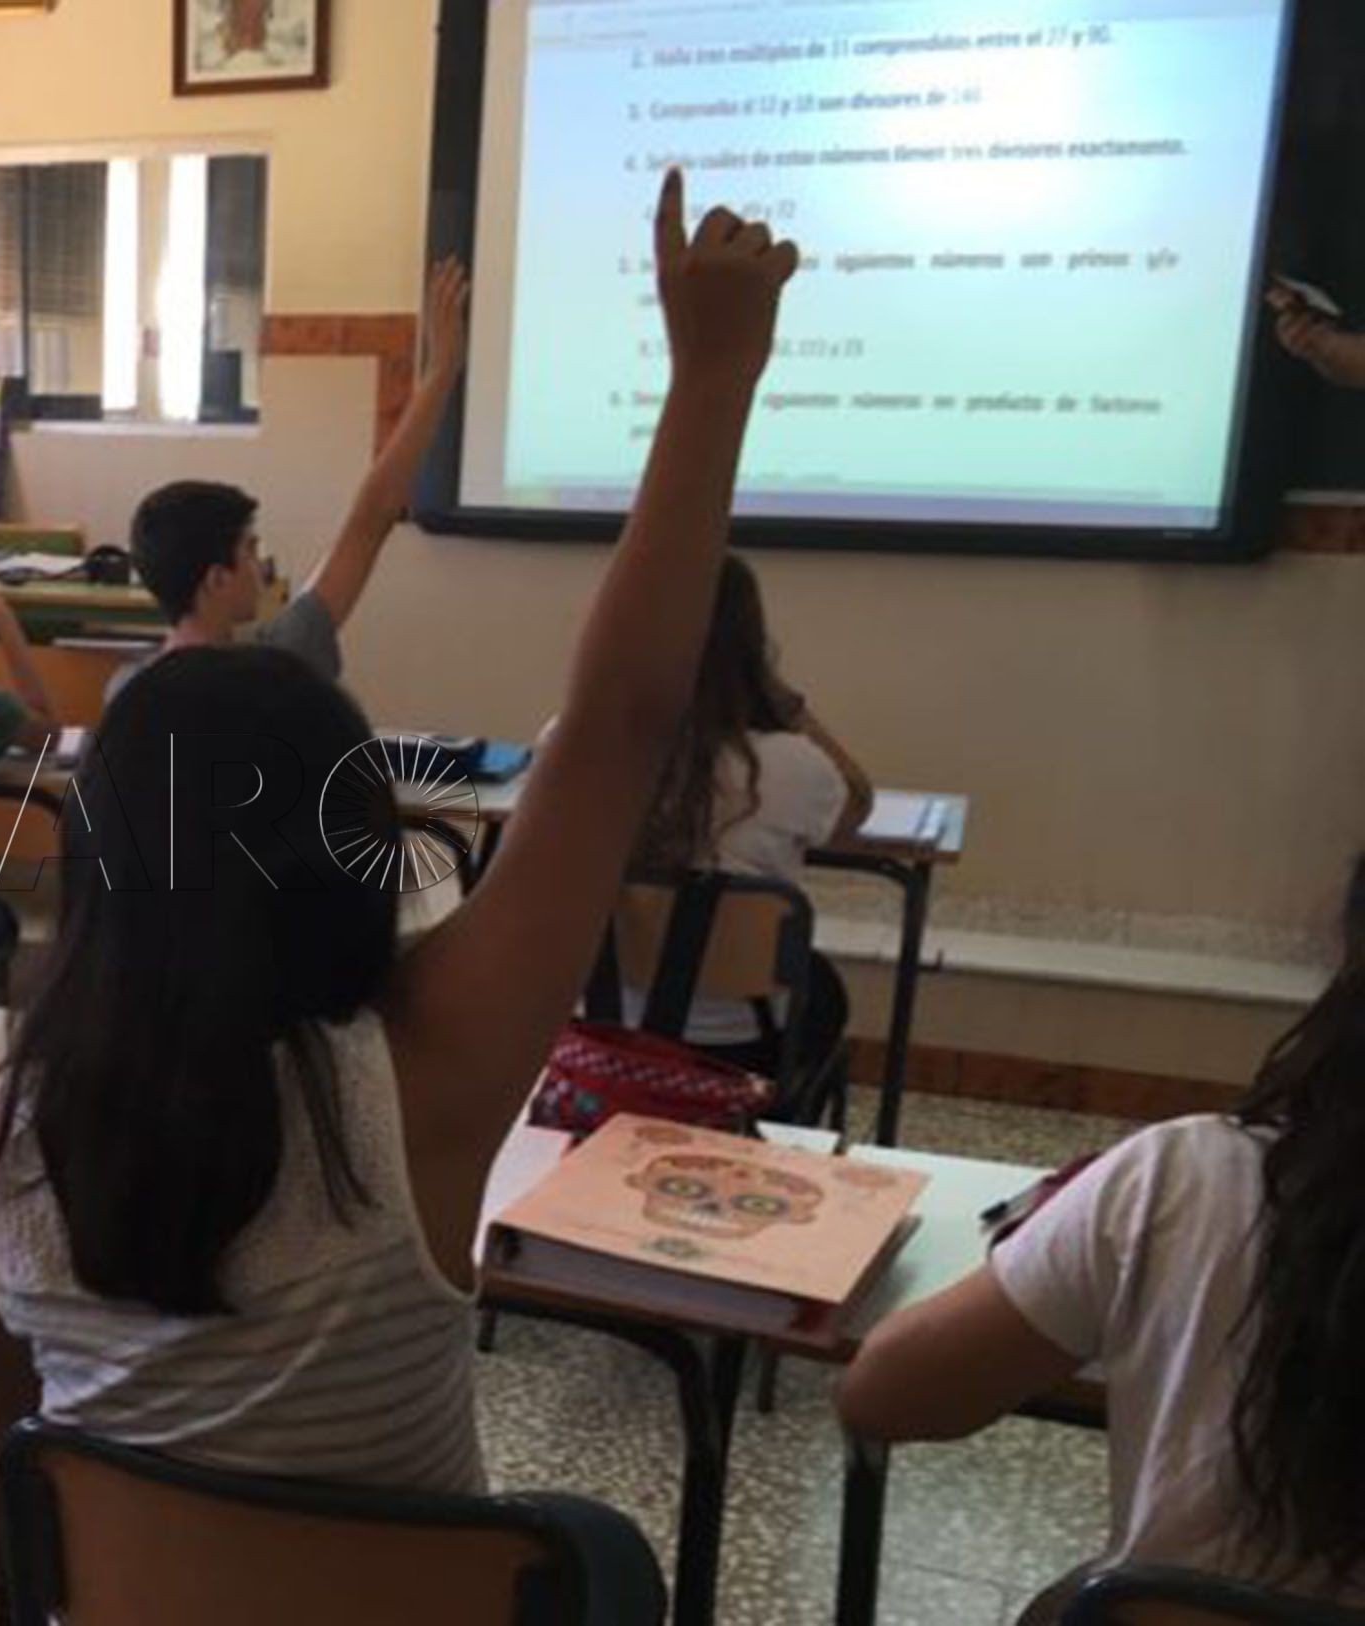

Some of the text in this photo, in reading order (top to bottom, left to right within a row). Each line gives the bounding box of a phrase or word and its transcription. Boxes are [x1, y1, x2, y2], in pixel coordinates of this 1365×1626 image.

[696, 46, 726, 64] tres
[806, 40, 825, 58] de
[853, 34, 970, 57] comprendidos
[976, 31, 1022, 47] entre
[1026, 29, 1042, 46] el
[1072, 31, 1083, 48] y
[818, 96, 845, 111] son
[851, 91, 921, 111] divisores
[927, 89, 947, 106] de
[752, 149, 770, 167] de
[775, 150, 815, 166] estos
[819, 145, 890, 164] números
[951, 143, 983, 160] tres
[988, 141, 1063, 160] divisores
[835, 252, 915, 274] siguientes
[931, 249, 1005, 268] números
[1021, 253, 1053, 268] son
[1068, 249, 1130, 271] primos
[851, 391, 922, 409] números
[966, 391, 1044, 412] producto
[1056, 393, 1076, 412] de
[1091, 393, 1161, 413] factores
